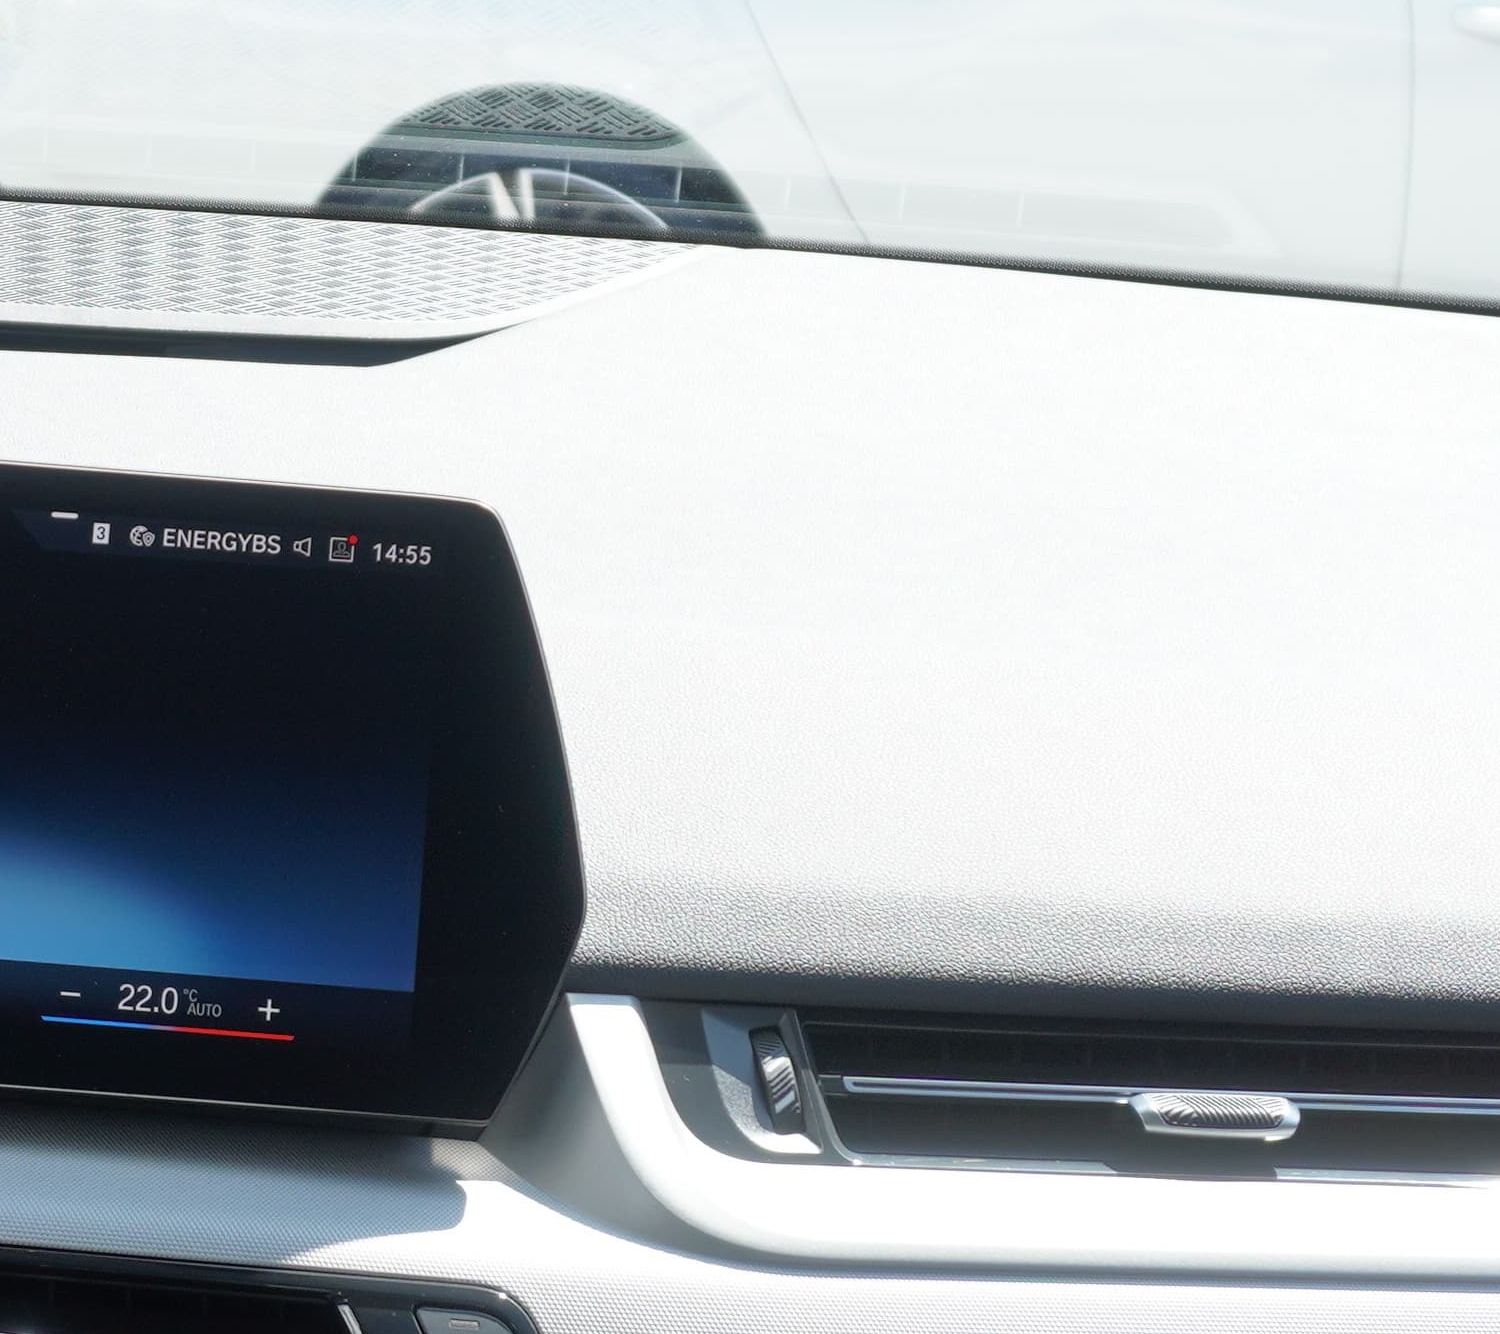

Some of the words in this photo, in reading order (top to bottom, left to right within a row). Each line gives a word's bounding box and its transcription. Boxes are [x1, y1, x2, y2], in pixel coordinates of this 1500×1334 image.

[163, 528, 282, 556] ENERGYBS
[373, 542, 433, 565] 14:55
[117, 982, 179, 1015] 22.0
[183, 988, 198, 1003] °C
[186, 1002, 222, 1018] AUTO
